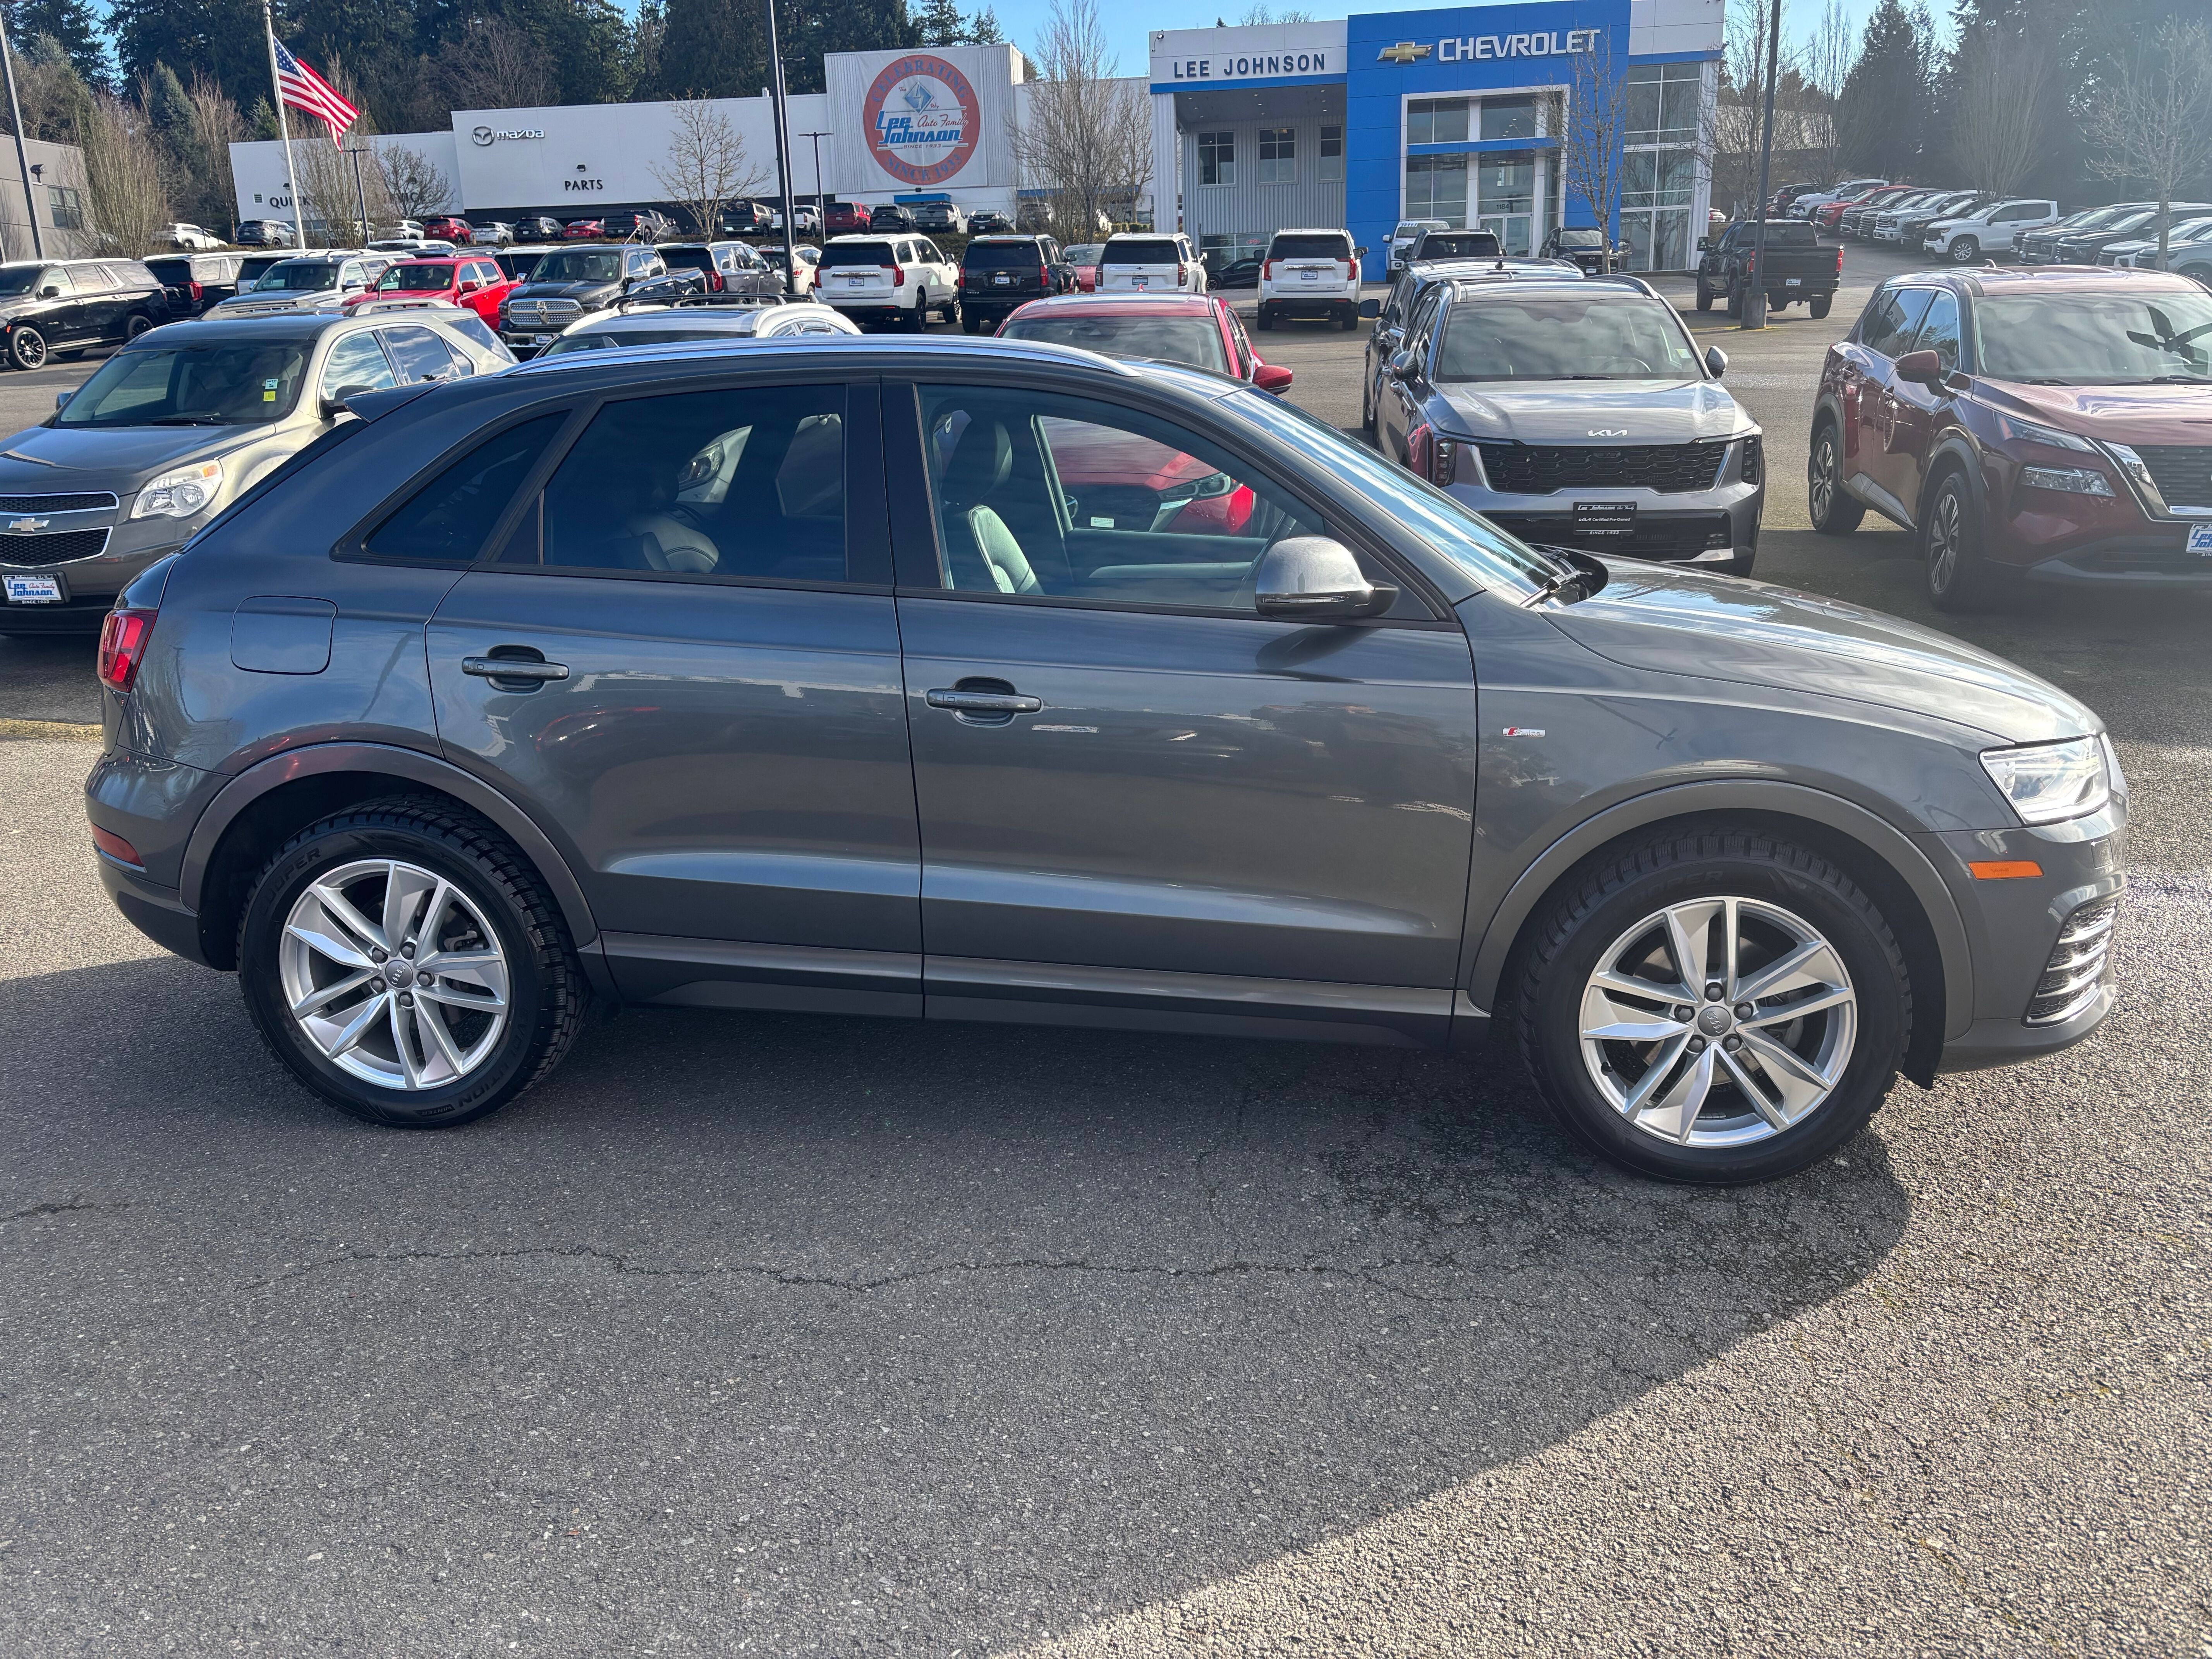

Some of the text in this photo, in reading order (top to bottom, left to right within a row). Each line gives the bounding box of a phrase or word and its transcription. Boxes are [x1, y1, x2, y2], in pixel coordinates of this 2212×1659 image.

[1438, 29, 1601, 61] CHEVROLET
[1174, 53, 1325, 78] LEE JOHNSON
[872, 60, 969, 102] CELEBRATING
[876, 110, 969, 130] Lee Auto Family
[496, 129, 545, 140] mazda
[878, 125, 963, 144] Johnson
[885, 153, 962, 181] SINCE 1933
[564, 179, 603, 191] PARTS
[8, 580, 27, 589] Lee
[11, 587, 55, 596] Johnson
[1513, 728, 1523, 736] S
[421, 1104, 453, 1116] WINTER
